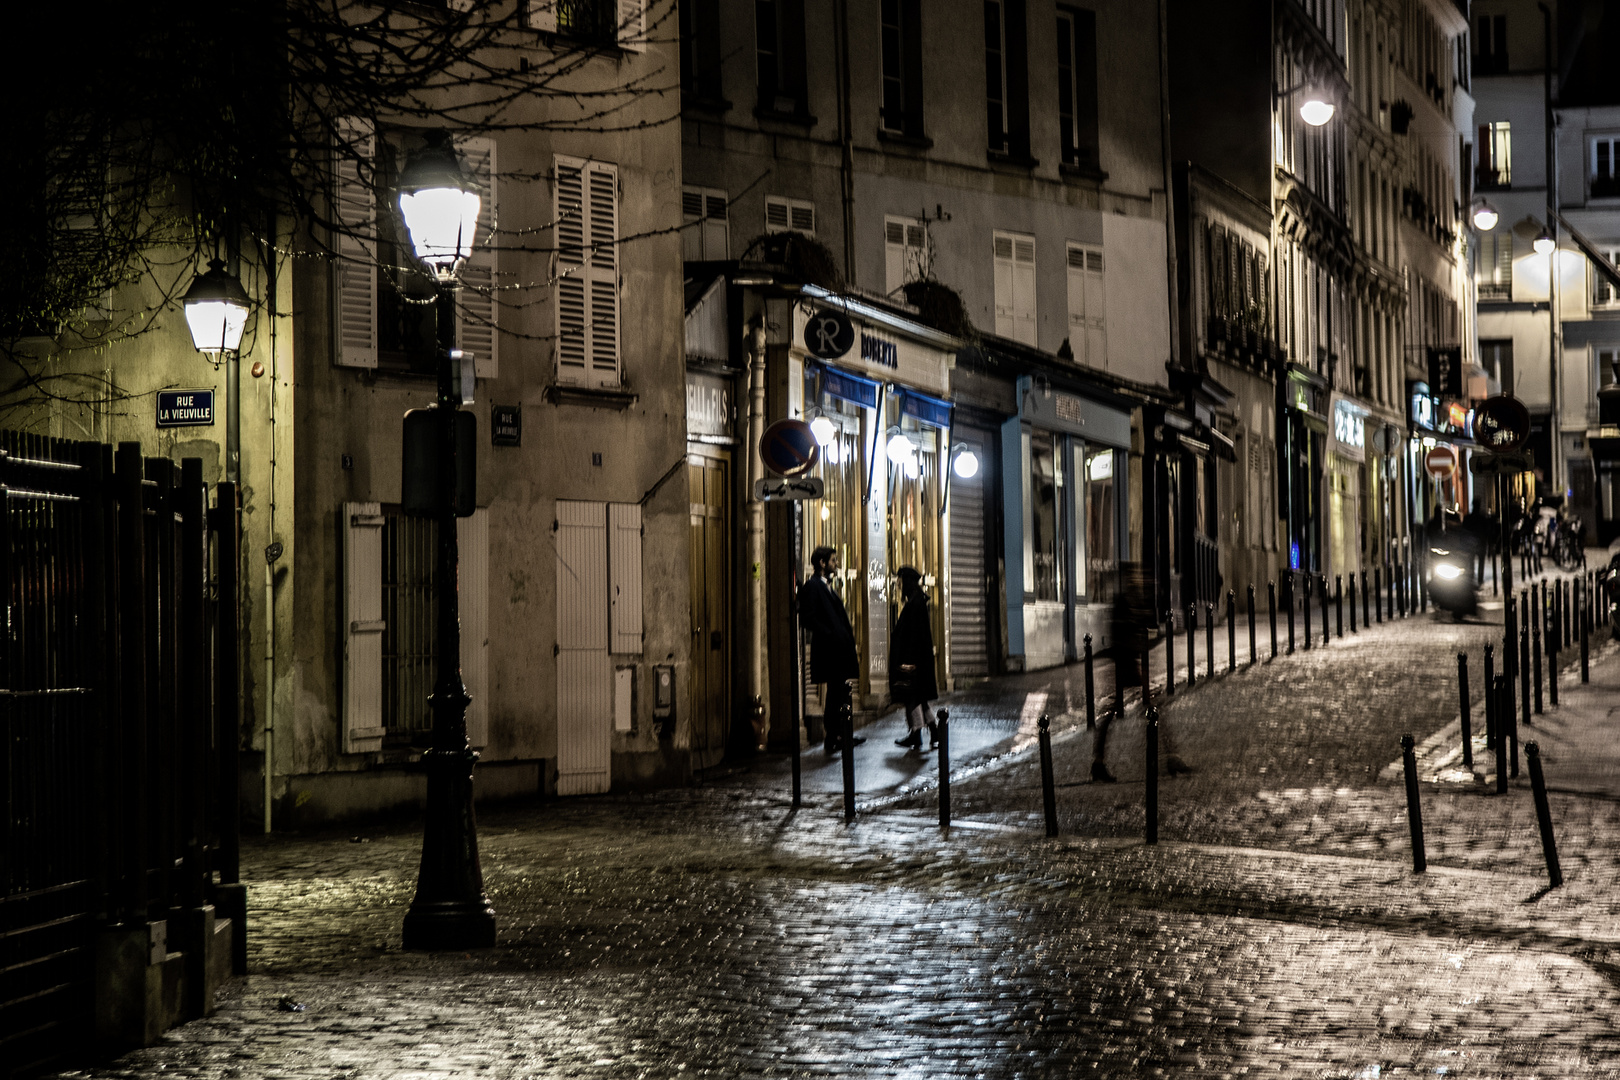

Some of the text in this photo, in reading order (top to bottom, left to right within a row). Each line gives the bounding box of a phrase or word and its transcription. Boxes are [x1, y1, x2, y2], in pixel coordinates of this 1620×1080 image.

[816, 316, 843, 353] R
[861, 333, 898, 369] ROBERTA
[160, 407, 210, 420] LA VIEUVILLE
[176, 396, 194, 407] RUE
[711, 387, 728, 425] FILS
